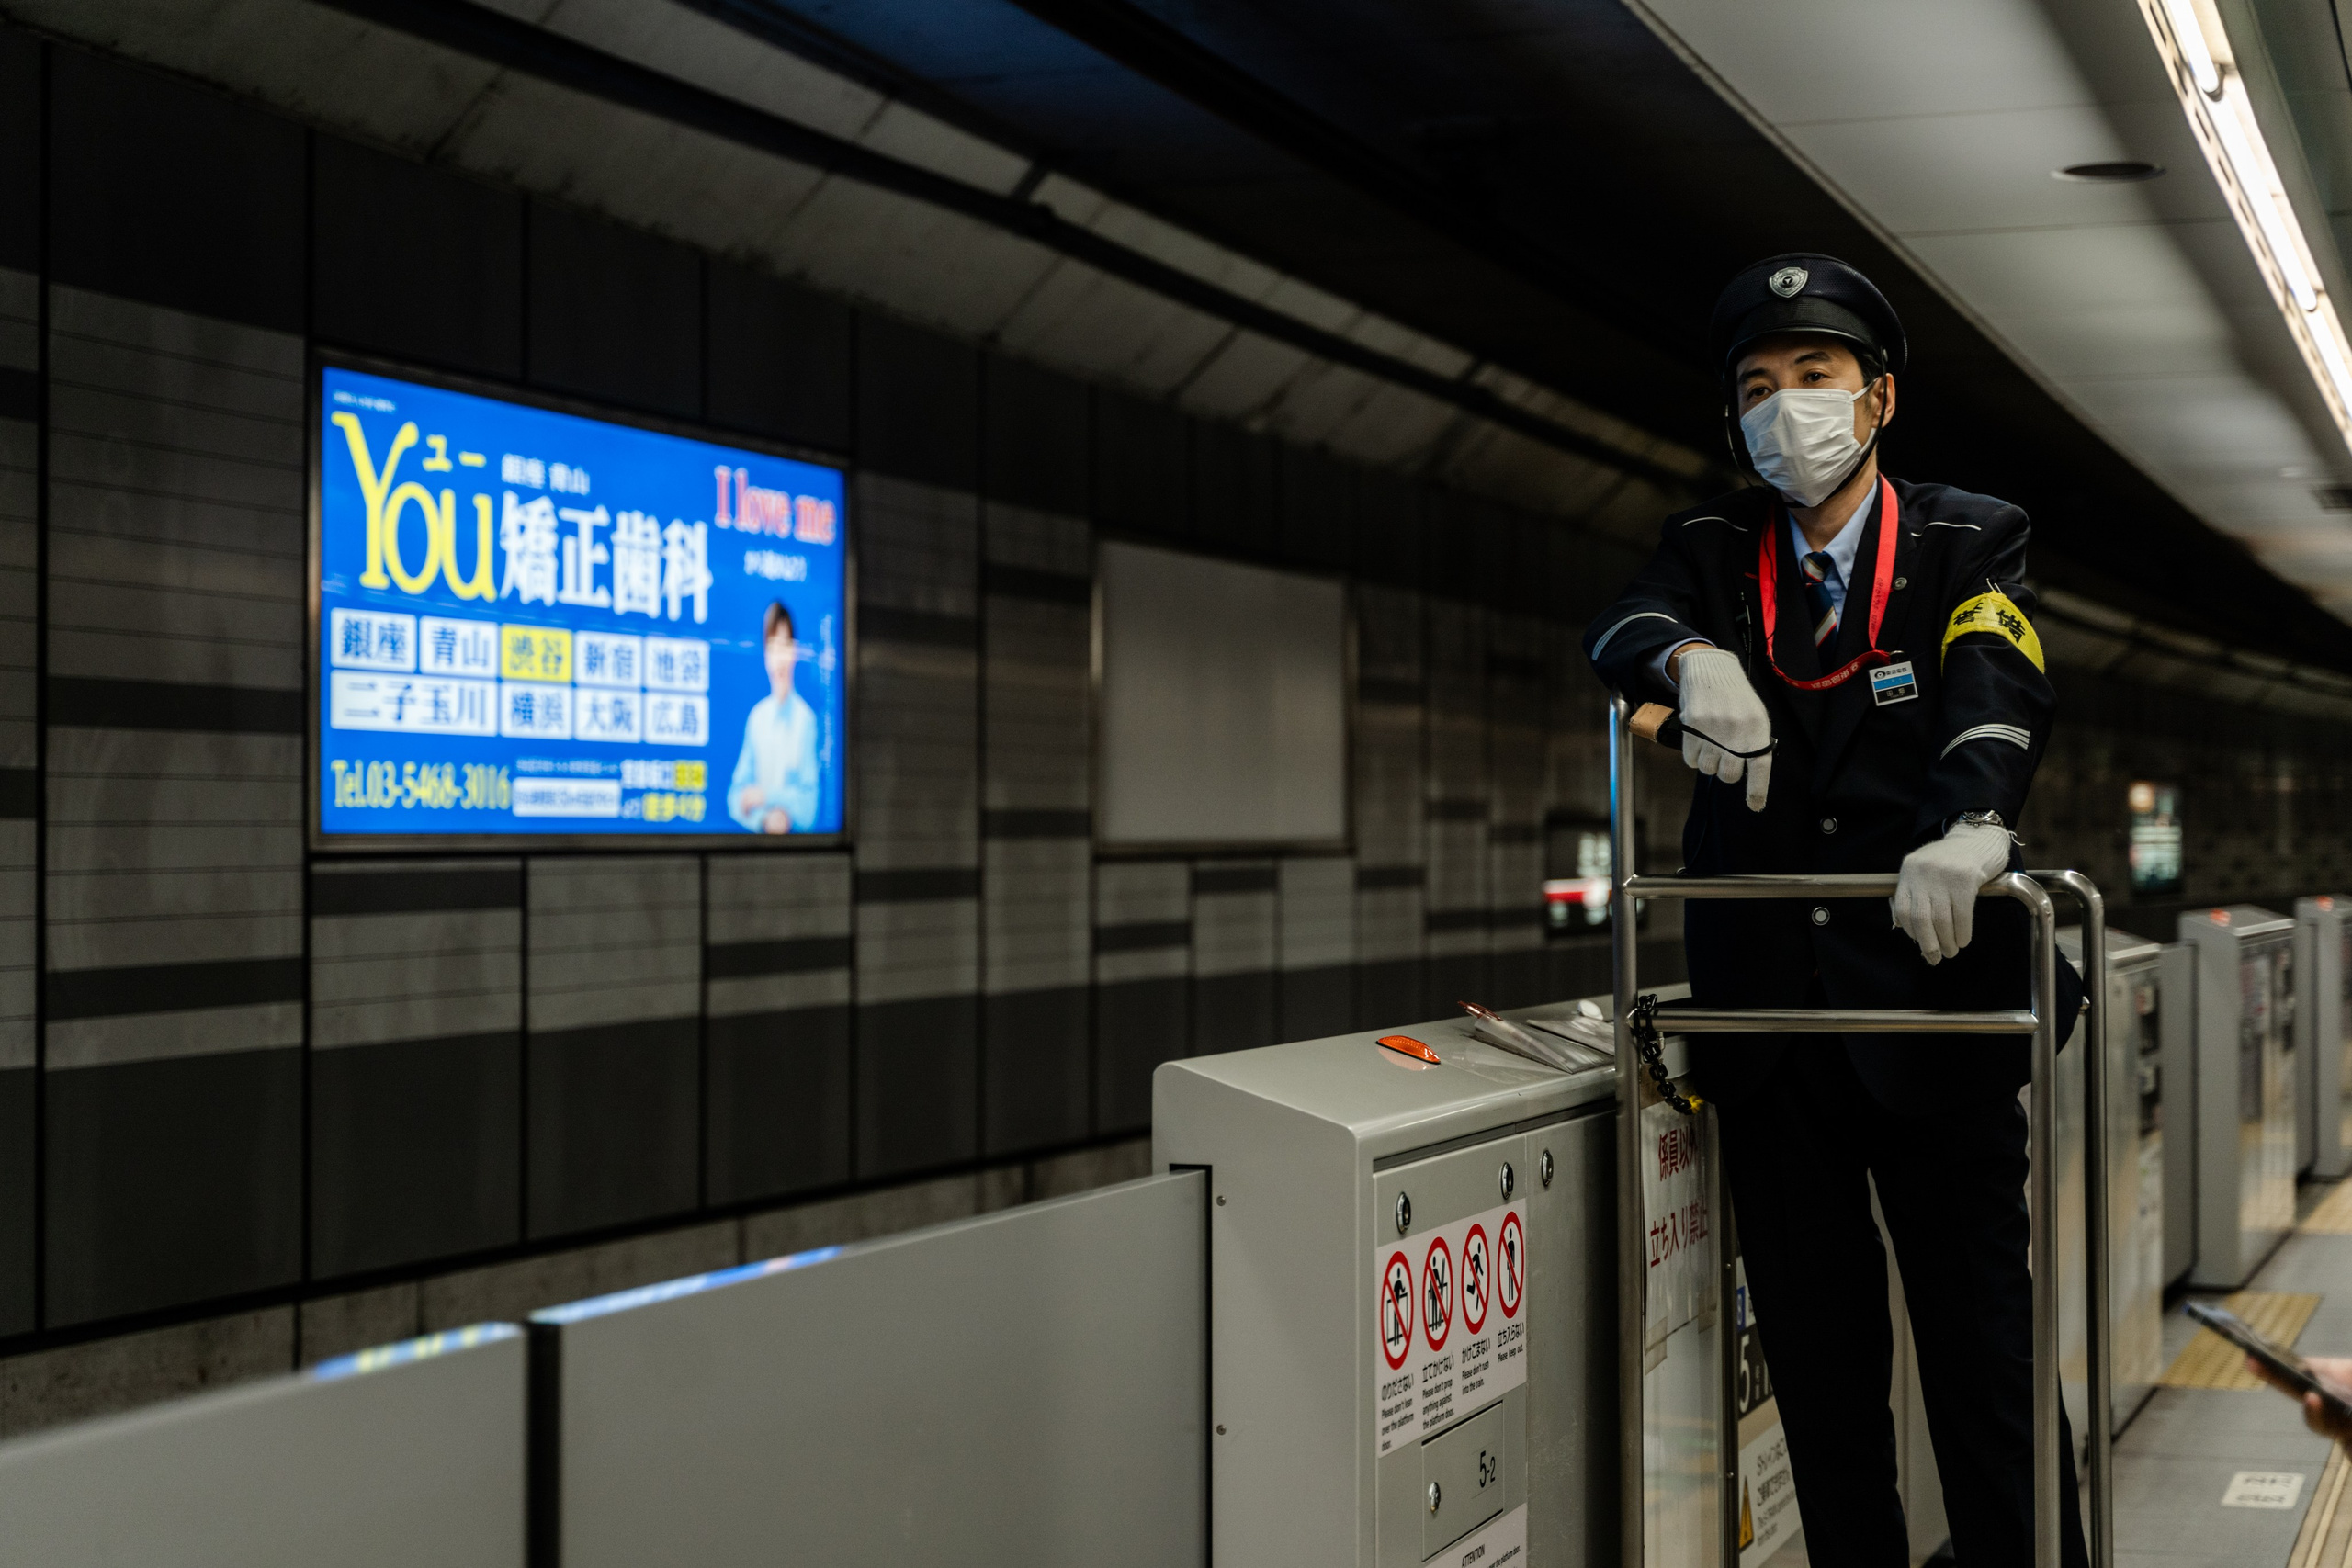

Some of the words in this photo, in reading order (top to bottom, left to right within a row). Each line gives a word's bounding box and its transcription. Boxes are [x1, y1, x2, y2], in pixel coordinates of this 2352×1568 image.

[422, 434, 487, 472] ユー
[331, 411, 497, 603] You
[714, 465, 732, 529] I
[734, 467, 791, 539] love
[793, 494, 836, 546] me
[499, 489, 714, 624] 矯正歯科
[341, 618, 407, 664] 銀座
[431, 625, 490, 668] 青山
[509, 634, 563, 676] 渋谷
[584, 640, 634, 679] 新宿
[651, 647, 702, 683] 池袋
[344, 681, 487, 727] 二子玉川
[511, 692, 564, 729] 横浜
[582, 694, 634, 733] 大阪
[651, 699, 700, 737] 広島
[1658, 1126, 1699, 1181] 係員以外
[1650, 1198, 1709, 1268] 立ち入り禁止
[1498, 1321, 1524, 1348] 立ち入らない
[1462, 1337, 1490, 1364] かけこまない
[1498, 1351, 1508, 1363] Please
[1422, 1352, 1454, 1383] 立てかけない
[1462, 1369, 1473, 1381] Please
[1382, 1373, 1414, 1402] のりださない
[1422, 1388, 1433, 1400] Please
[1444, 1379, 1453, 1392] prop
[1382, 1407, 1394, 1420] Please
[1405, 1398, 1413, 1408] lean
[1422, 1401, 1439, 1416] anything
[1439, 1393, 1452, 1408] against
[1382, 1425, 1390, 1436] over
[1397, 1413, 1414, 1430] platform
[1430, 1413, 1445, 1429] platform
[1462, 1544, 1485, 1568] ATTENTION
